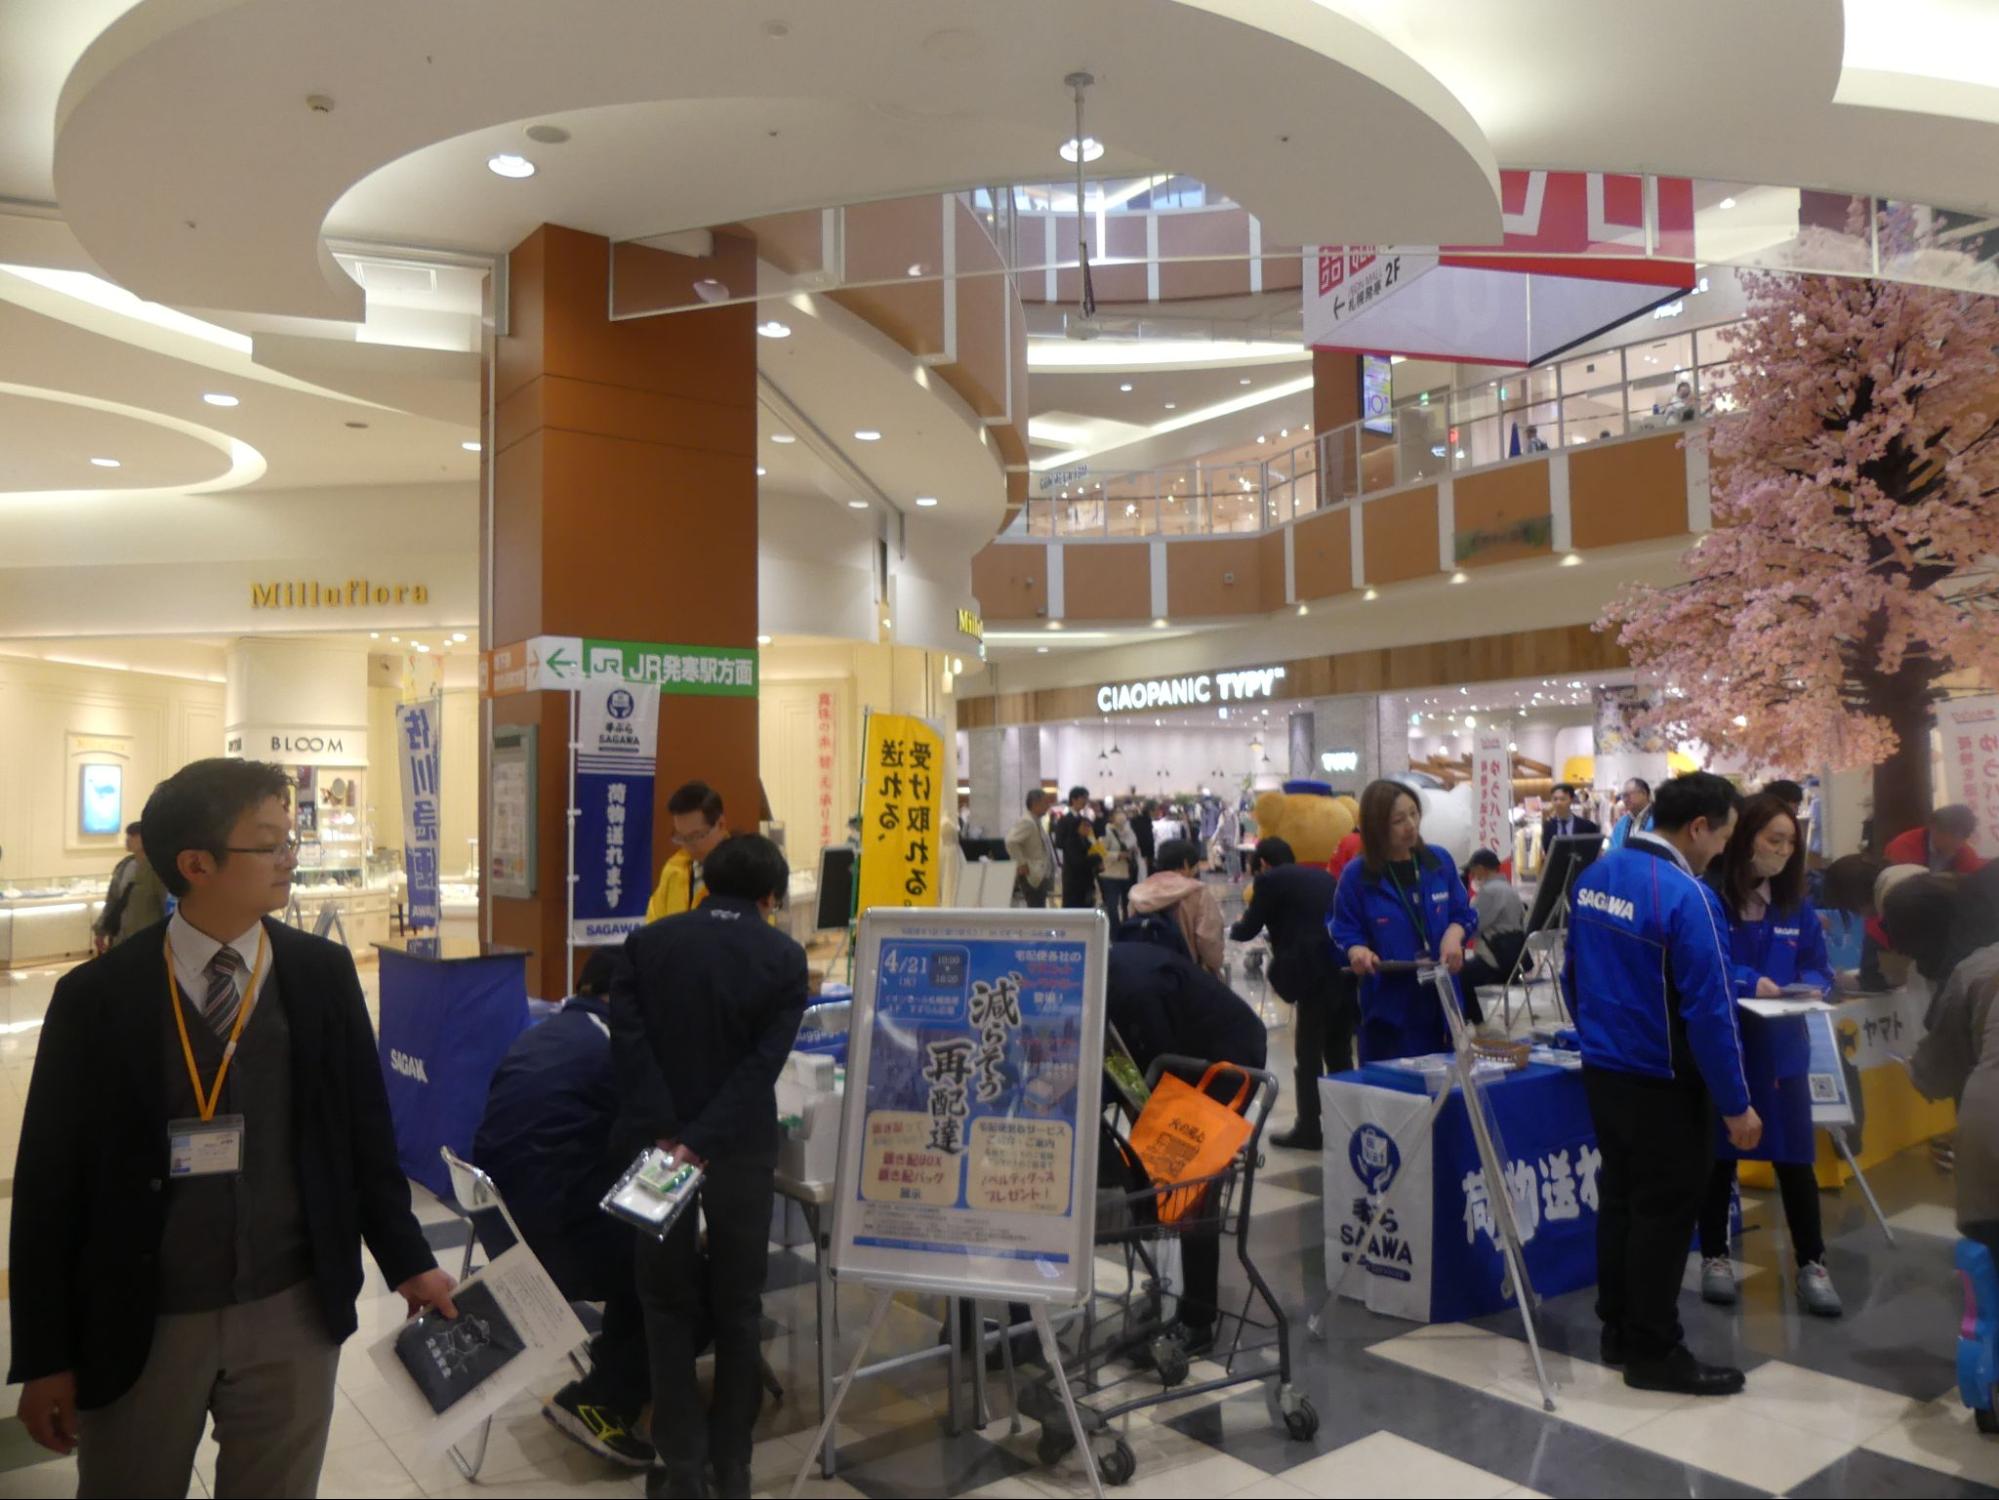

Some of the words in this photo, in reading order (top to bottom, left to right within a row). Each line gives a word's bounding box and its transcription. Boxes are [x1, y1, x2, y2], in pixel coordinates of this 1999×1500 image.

[629, 653, 753, 686] JR発寒駅方面
[1098, 675, 1211, 712] CIAOPANIC
[271, 736, 344, 752] BLOOM
[599, 734, 640, 746] SAGAWA
[605, 782, 627, 909] 荷物送れます
[926, 1040, 975, 1154] 再配達
